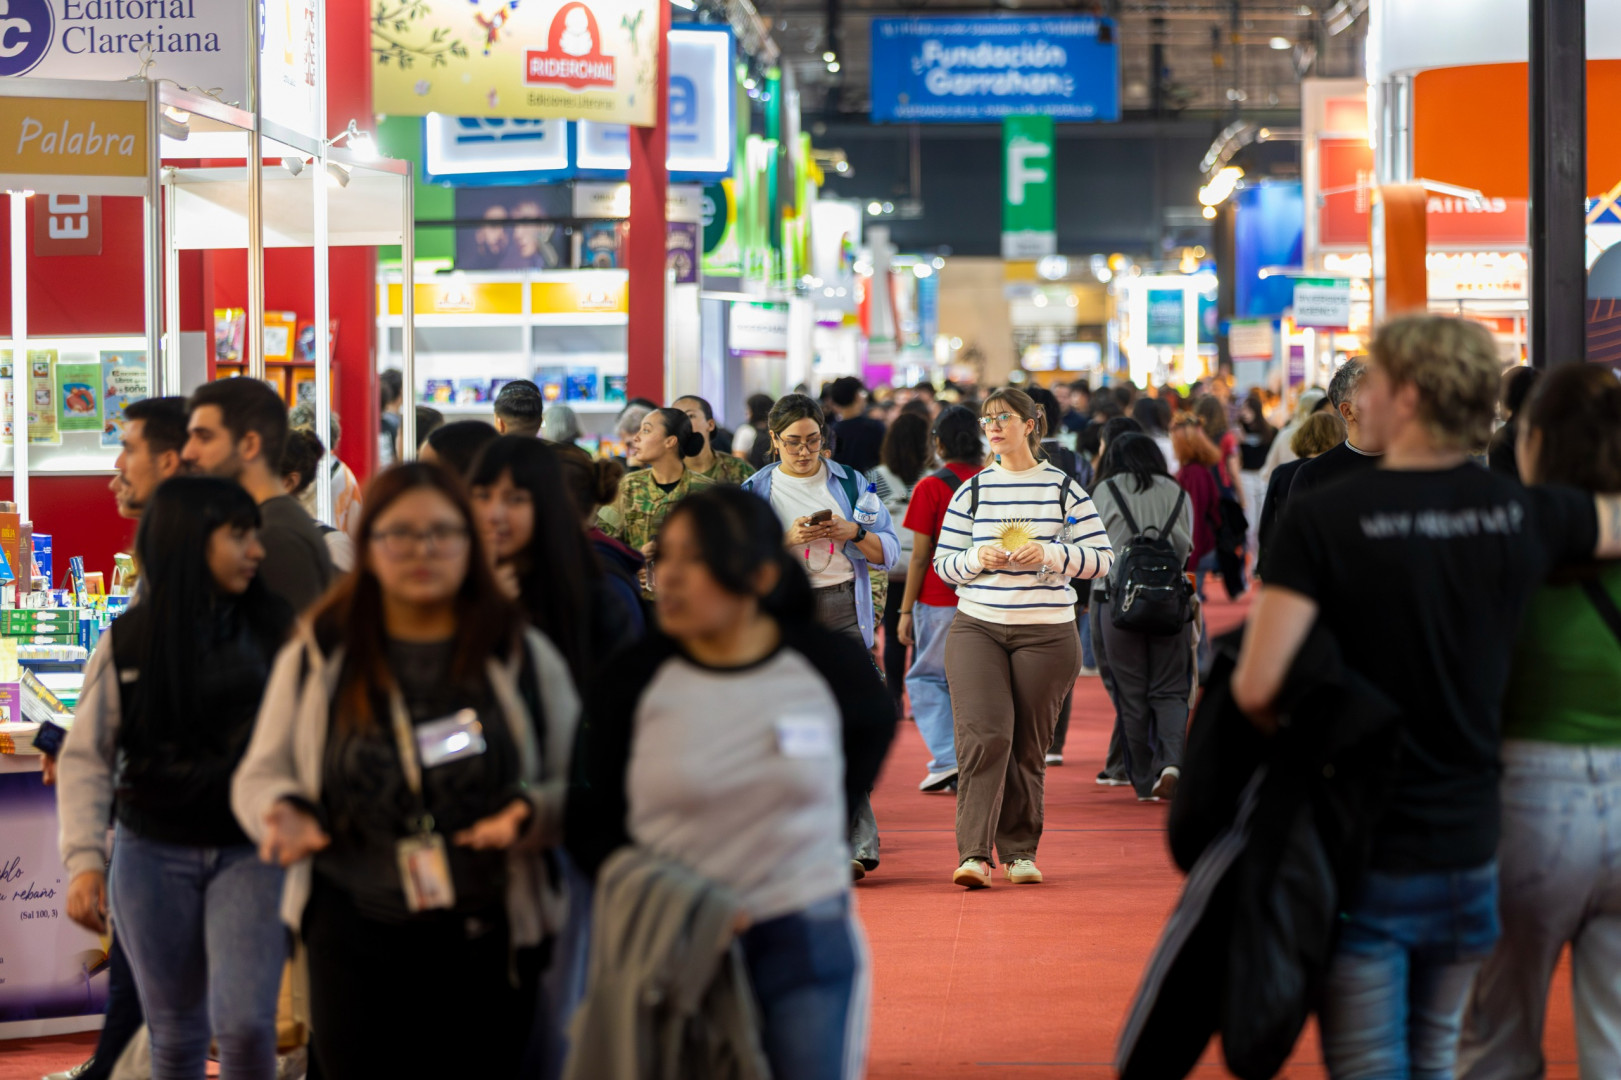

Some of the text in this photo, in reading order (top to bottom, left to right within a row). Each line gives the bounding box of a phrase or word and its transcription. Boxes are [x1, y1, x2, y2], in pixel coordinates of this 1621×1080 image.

[61, 0, 196, 20] Editorial
[62, 25, 221, 54] Claretiana
[921, 38, 1068, 69] Fundación
[17, 117, 136, 156] Palabra
[1007, 137, 1051, 205] F
[0, 856, 24, 882] blo
